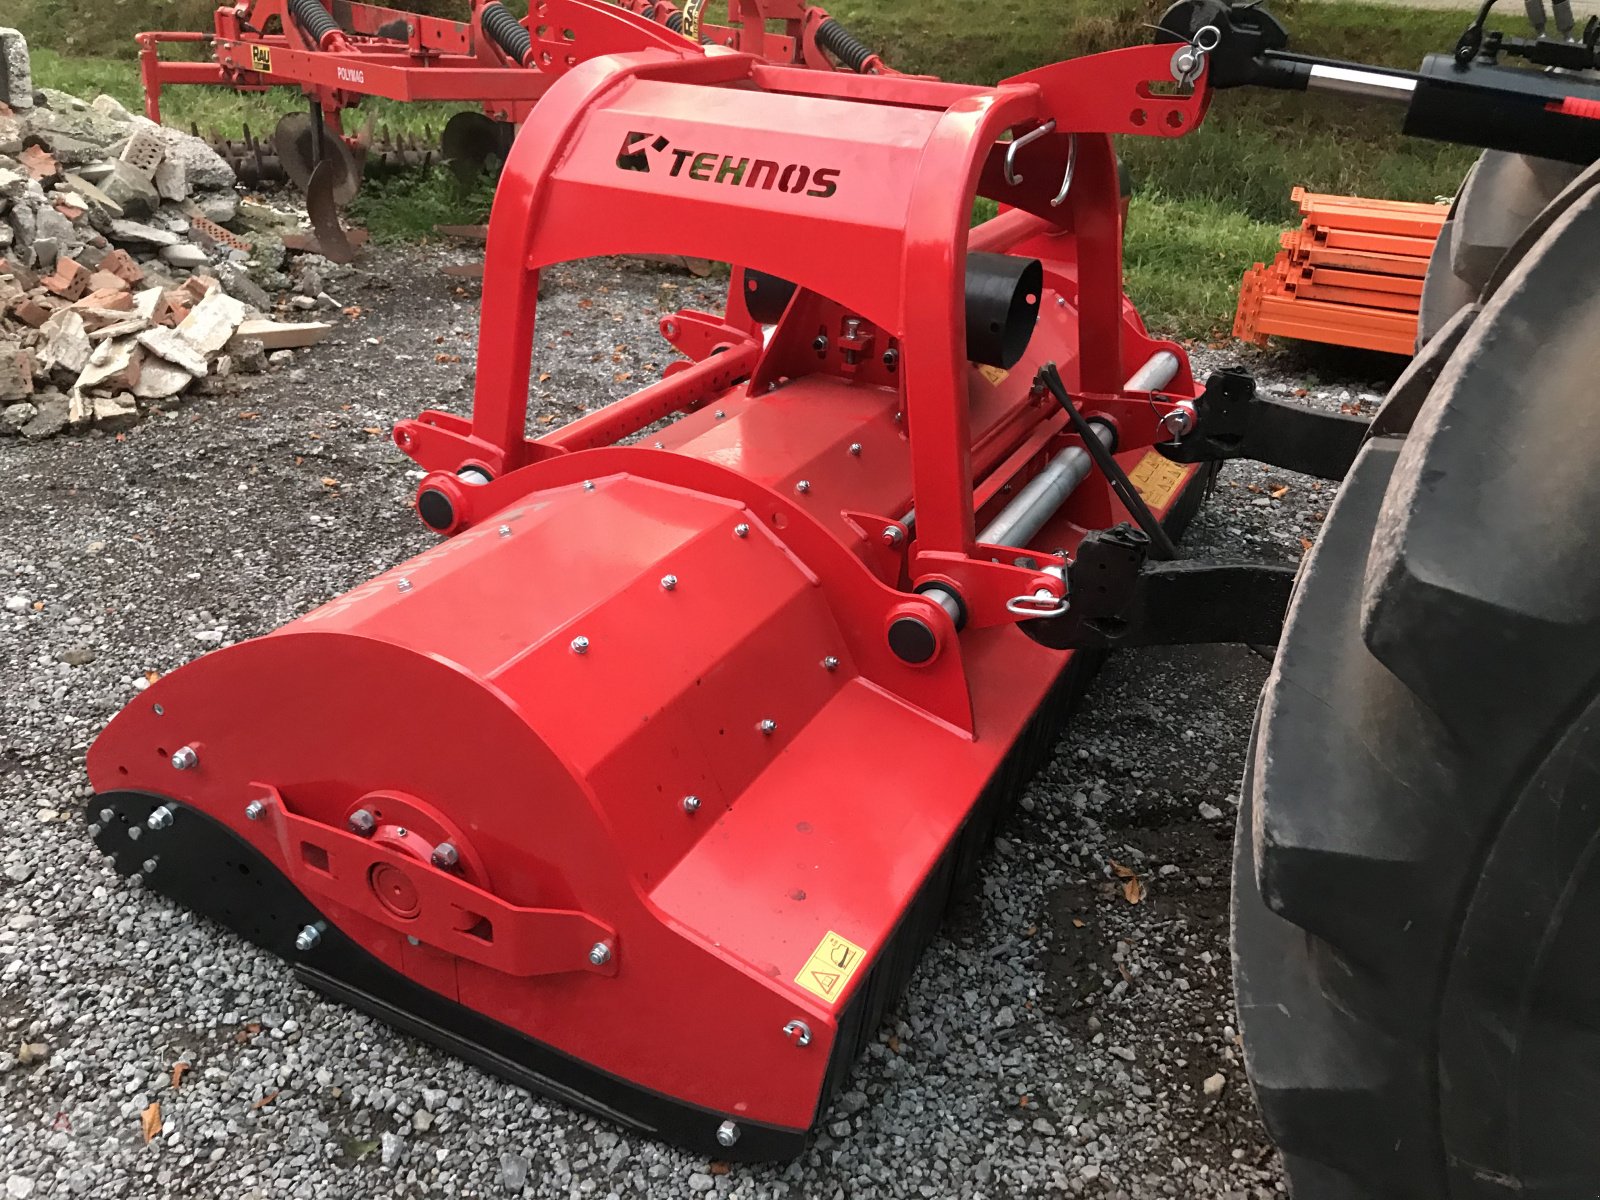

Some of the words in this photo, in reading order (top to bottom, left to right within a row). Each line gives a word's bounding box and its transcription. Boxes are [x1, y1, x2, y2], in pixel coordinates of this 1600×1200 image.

[253, 45, 270, 63] RAU
[337, 67, 364, 83] POLYMAG
[669, 148, 841, 198] TEHNOS
